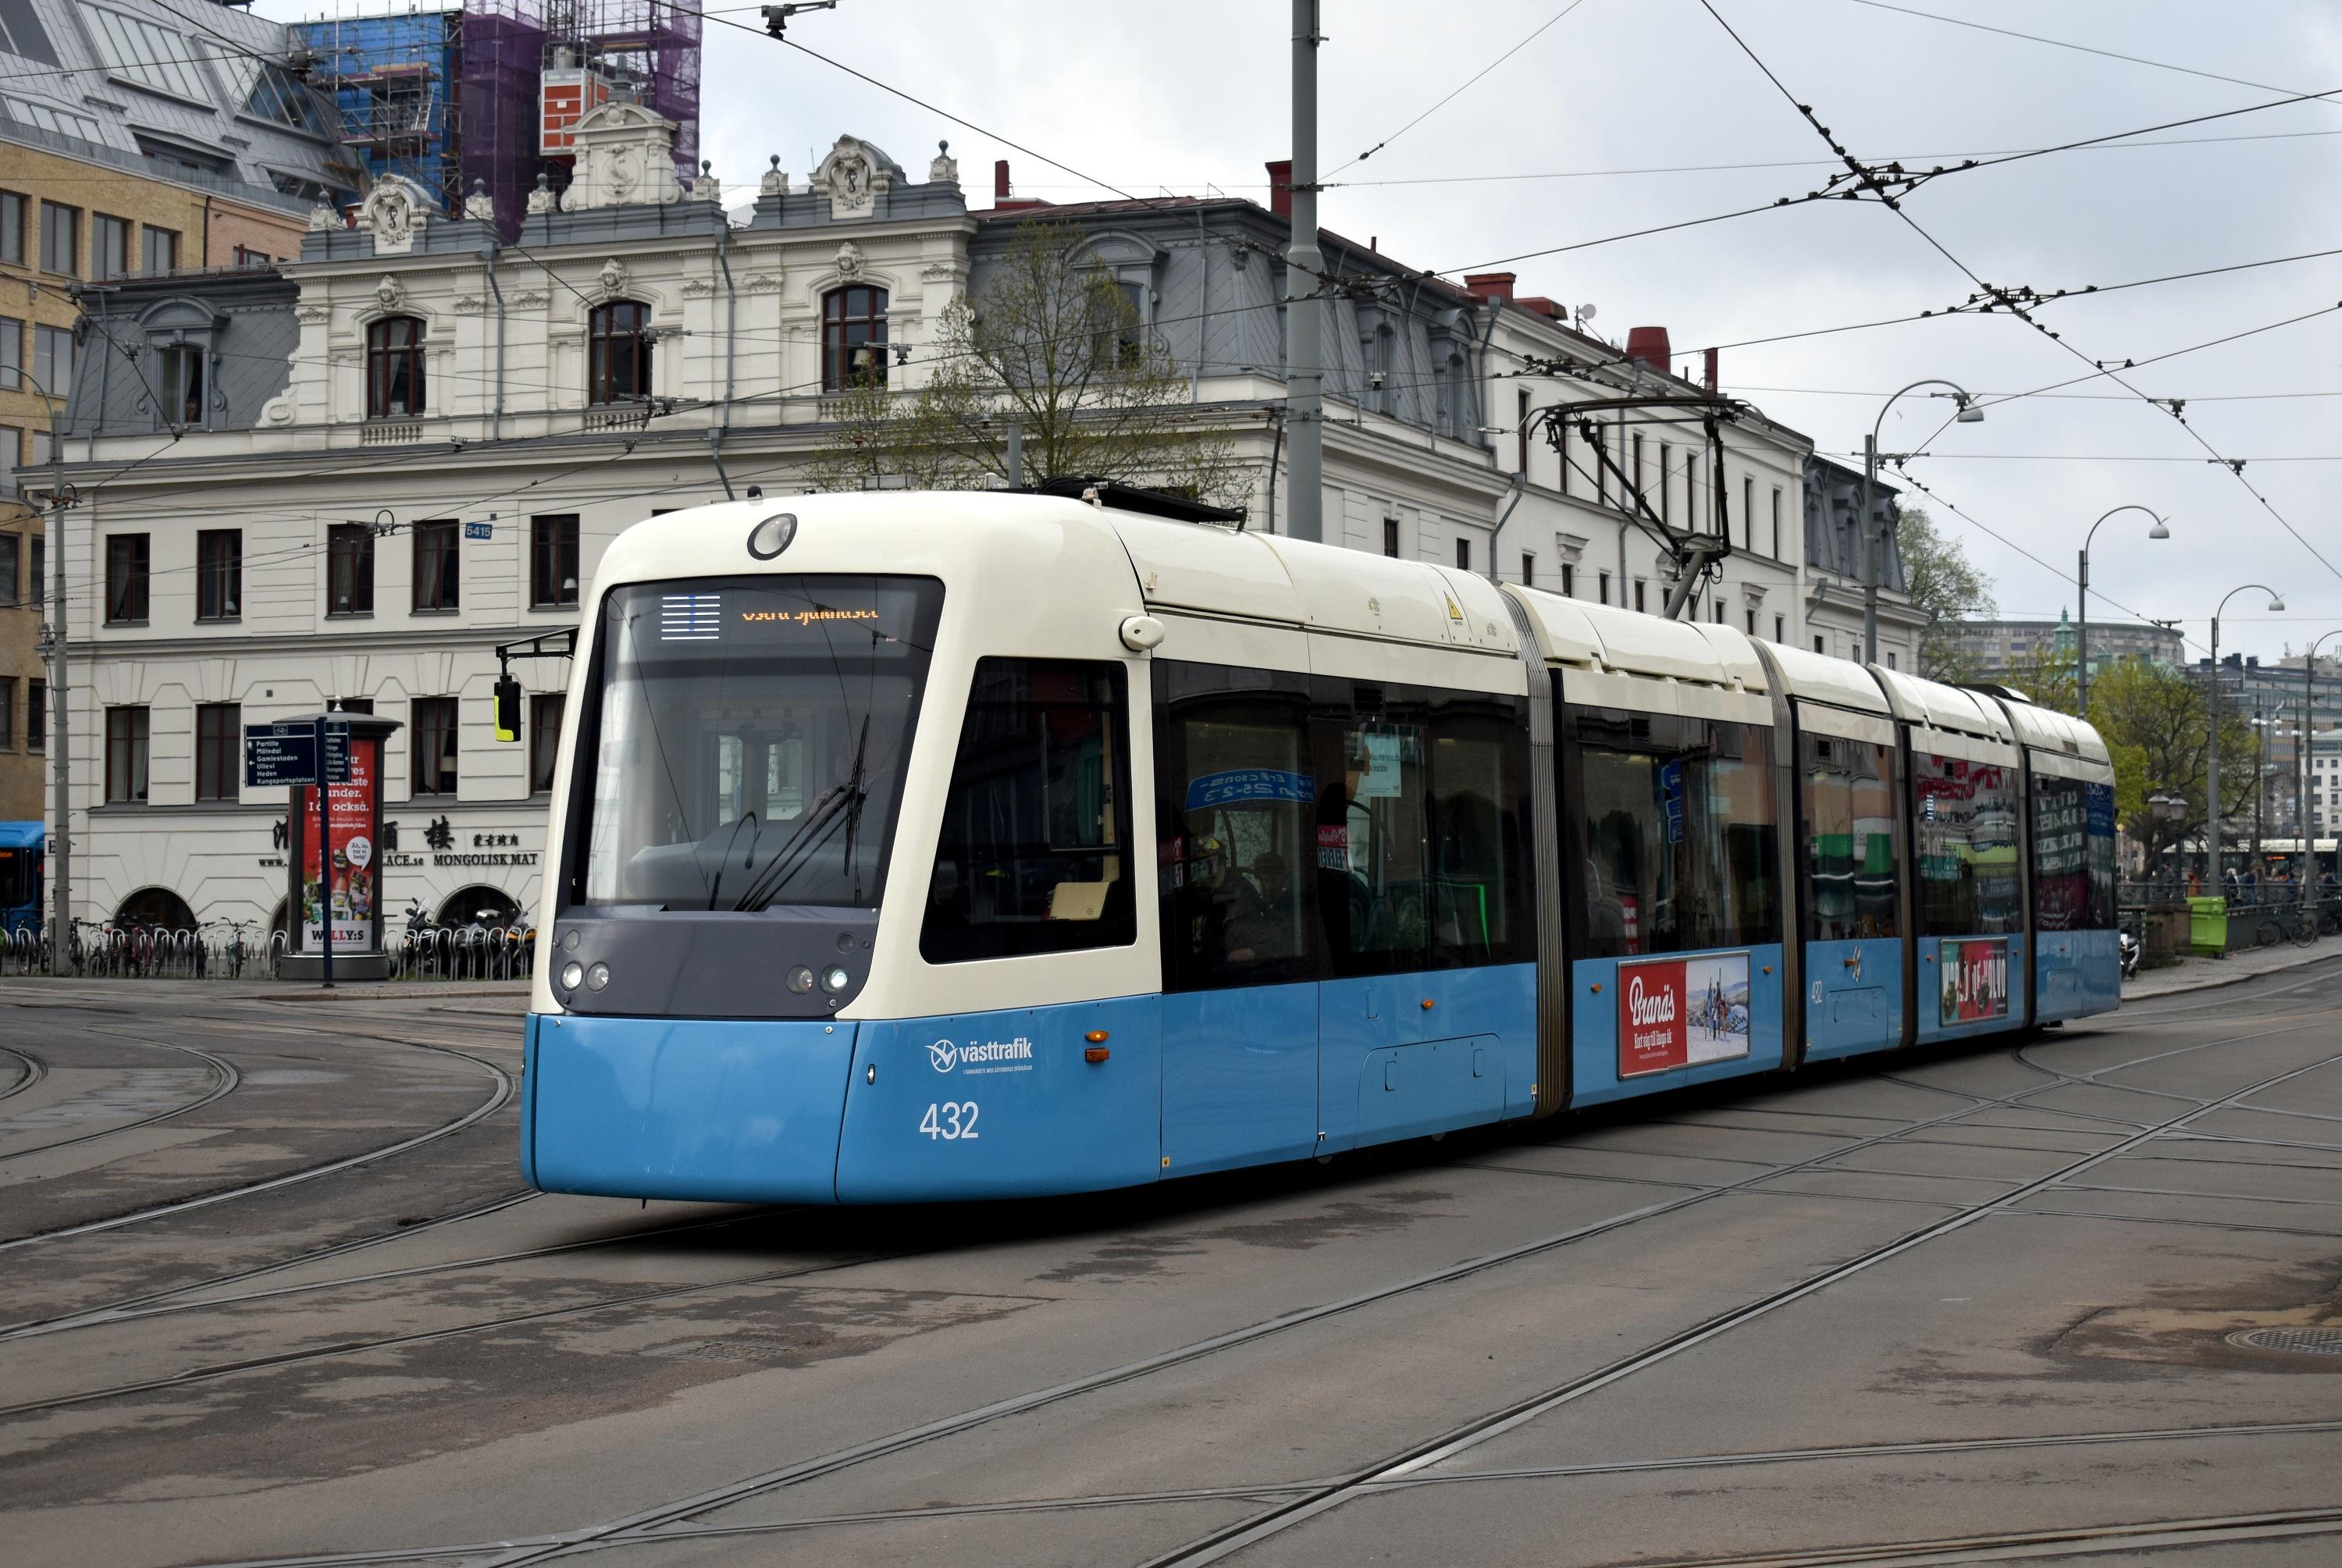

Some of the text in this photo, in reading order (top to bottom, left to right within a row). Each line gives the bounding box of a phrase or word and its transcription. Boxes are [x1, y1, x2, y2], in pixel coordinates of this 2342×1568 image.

[466, 525, 491, 537] 5415
[257, 777, 315, 785] Kungsportsplatsen
[332, 800, 369, 812] också.
[433, 853, 538, 866] MONGOLISK MAT
[311, 930, 365, 940] WLLY:S
[1811, 980, 1822, 1004] 432
[1628, 976, 1675, 1026] Branäs
[959, 1037, 1033, 1063] västtrafik
[920, 1101, 979, 1140] 432
